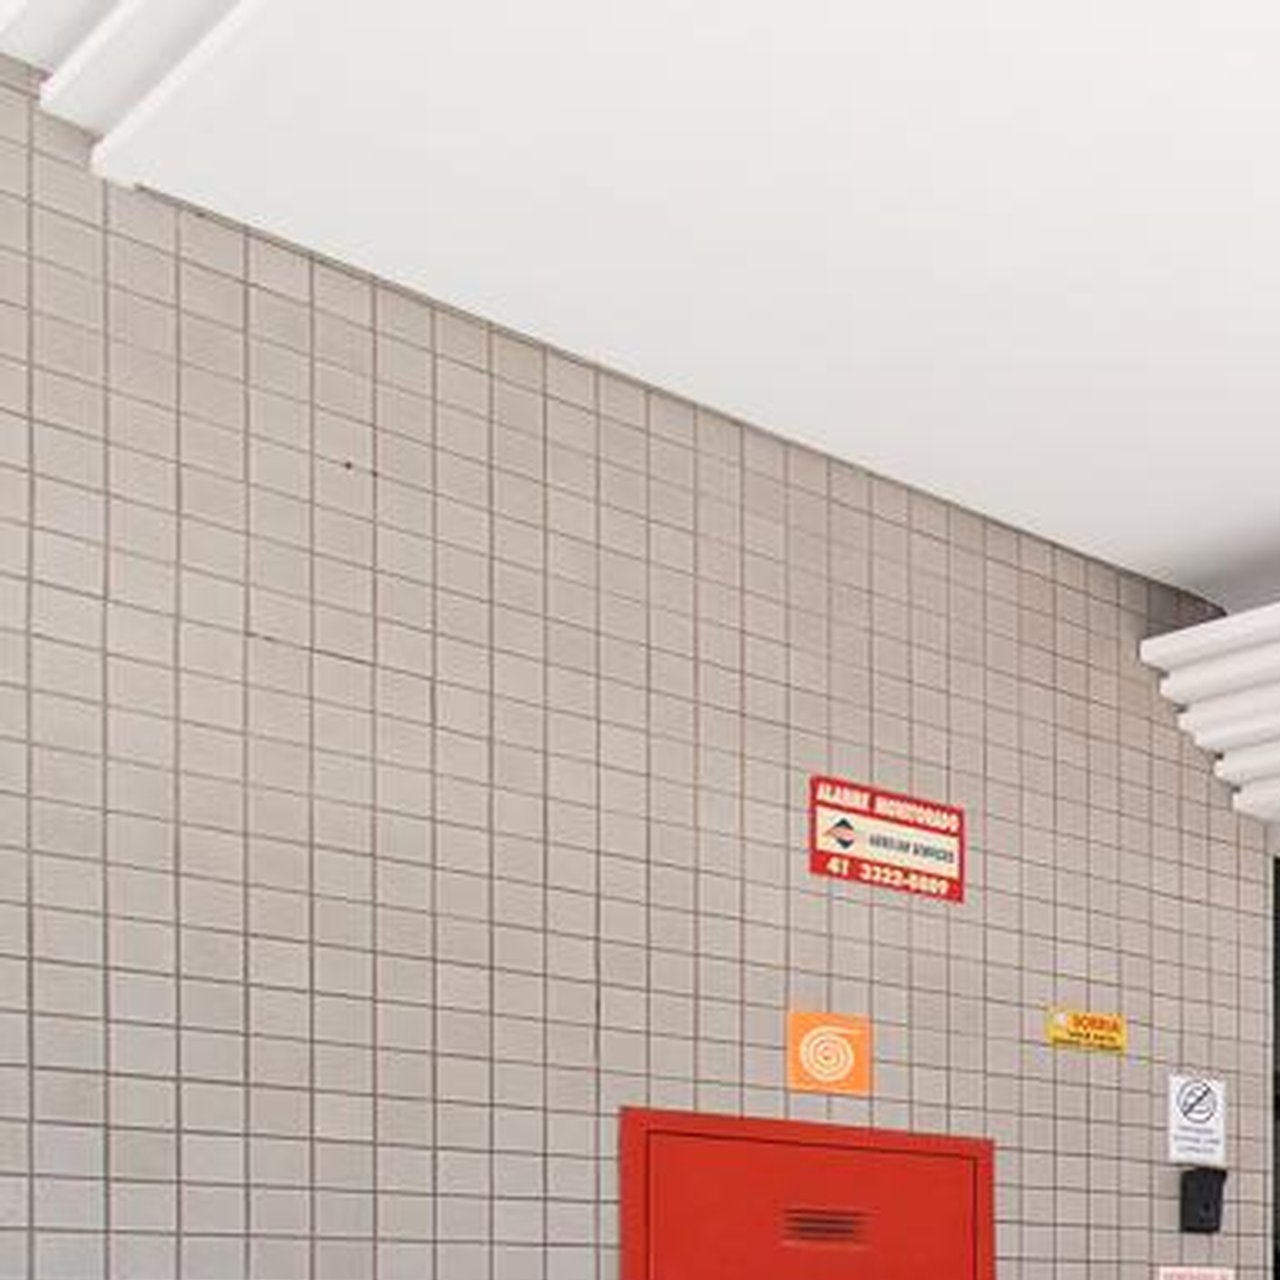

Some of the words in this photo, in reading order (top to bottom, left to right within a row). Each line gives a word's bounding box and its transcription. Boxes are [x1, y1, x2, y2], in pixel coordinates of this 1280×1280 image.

[816, 782, 870, 811] ALARME
[874, 796, 960, 833] MONITORADO
[826, 856, 850, 876] 41
